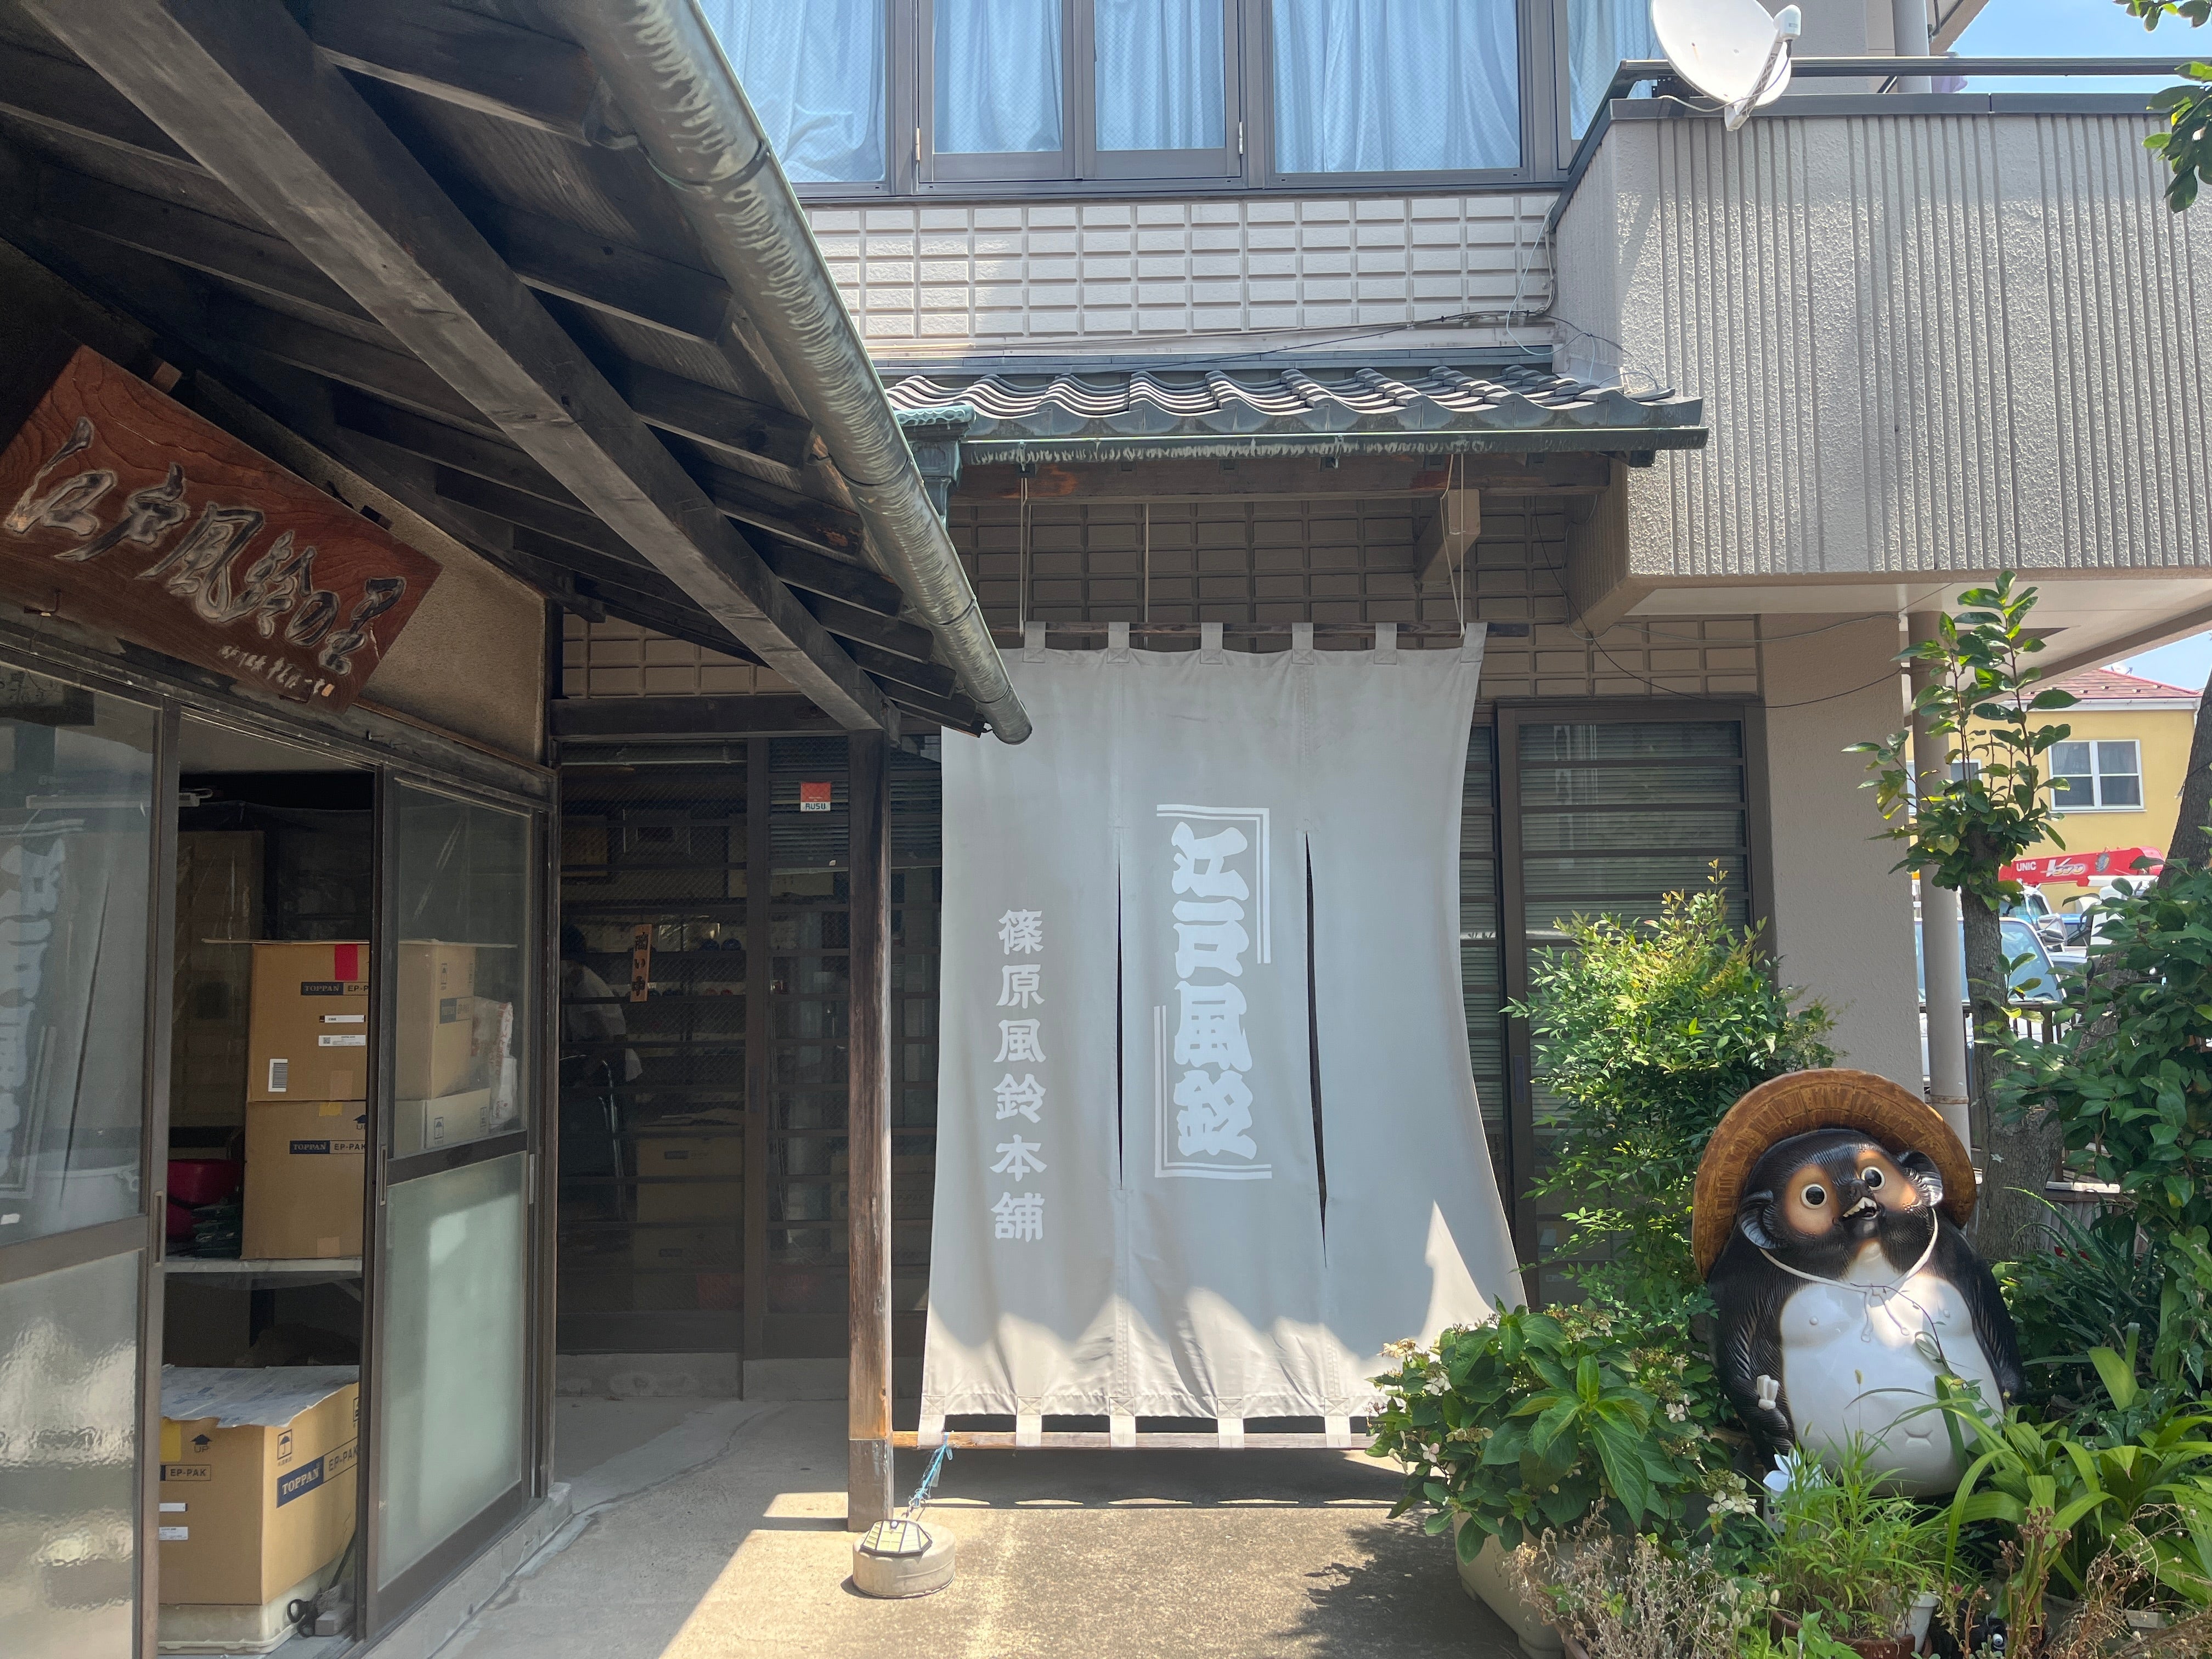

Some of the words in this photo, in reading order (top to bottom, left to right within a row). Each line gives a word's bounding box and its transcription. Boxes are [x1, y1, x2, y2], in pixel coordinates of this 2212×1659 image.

[2016, 861, 2036, 872] UNIC
[1171, 821, 1258, 1160] 江戸風鈴
[193, 1445, 209, 1453] UP
[170, 1469, 207, 1477] EP-PAK
[281, 1467, 321, 1496] TOPPAN
